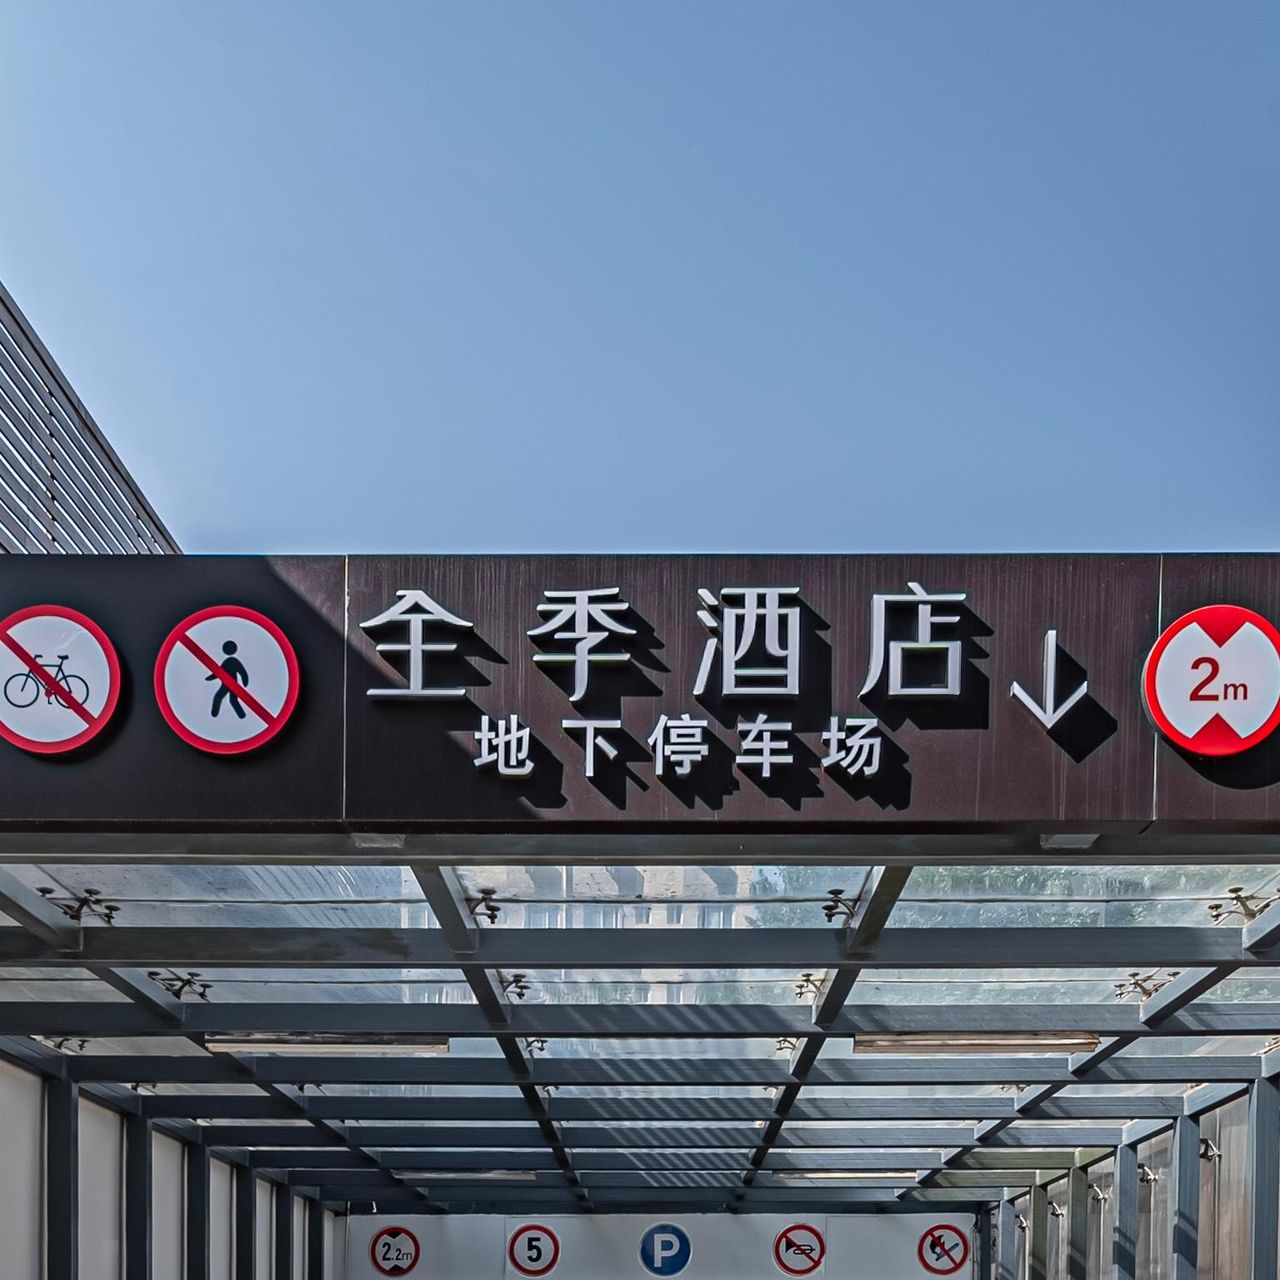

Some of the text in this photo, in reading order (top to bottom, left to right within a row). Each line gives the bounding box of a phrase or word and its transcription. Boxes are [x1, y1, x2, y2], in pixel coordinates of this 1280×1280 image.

[359, 582, 967, 701] 全季酒店
[1189, 657, 1249, 702] 2m
[473, 713, 883, 778] 地下停车场
[381, 1242, 413, 1262] 2.2m
[527, 1237, 543, 1263] 5
[653, 1233, 680, 1268] P
